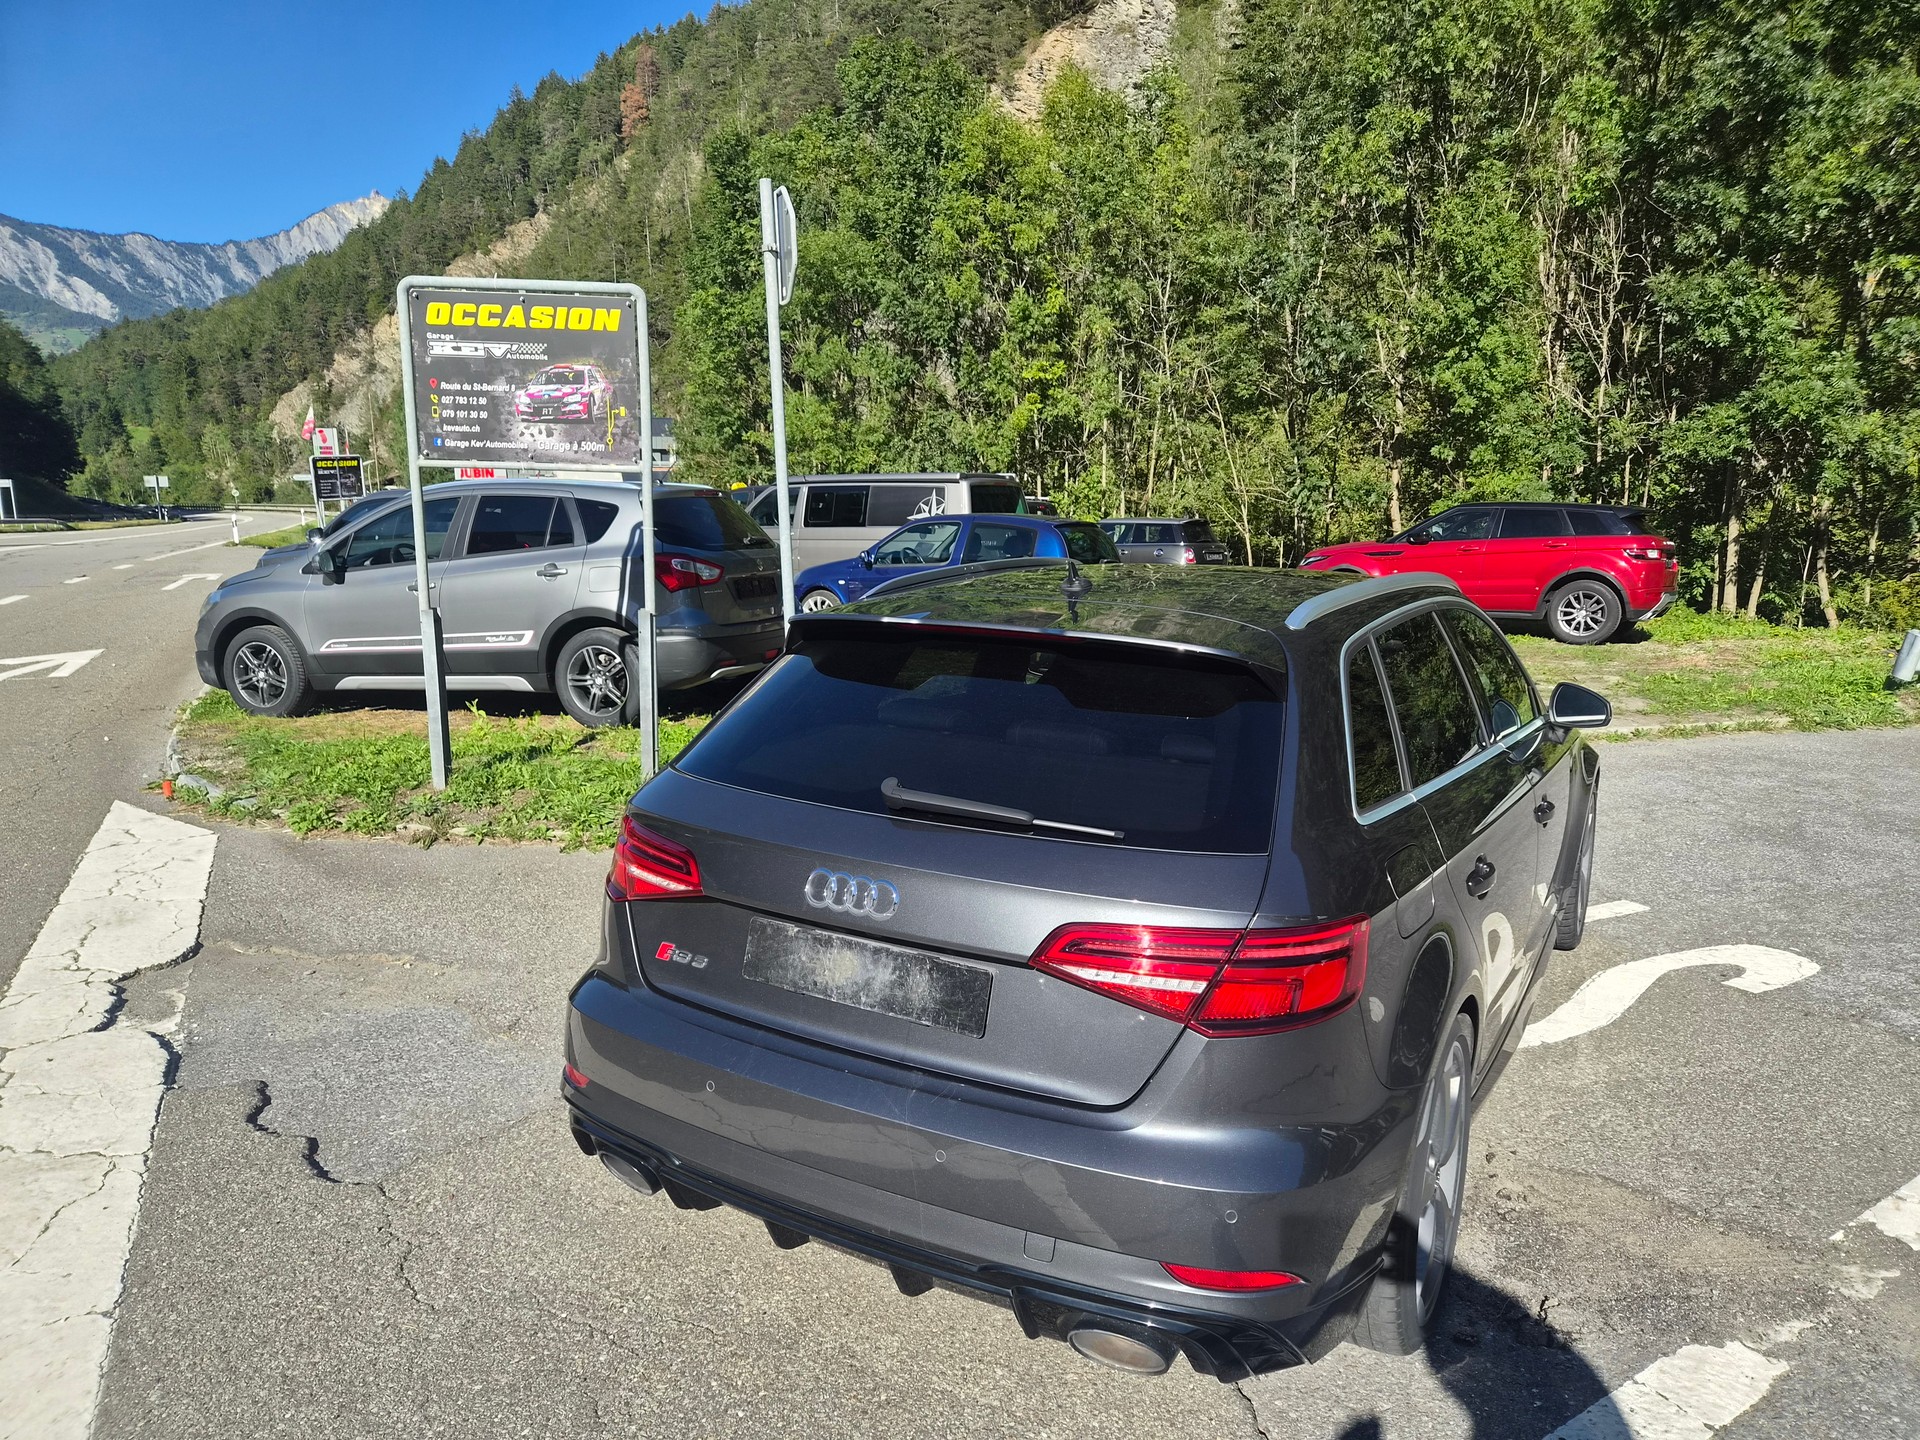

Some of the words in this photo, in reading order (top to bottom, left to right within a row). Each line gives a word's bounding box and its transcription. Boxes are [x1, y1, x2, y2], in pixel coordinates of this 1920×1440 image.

[425, 302, 622, 332] OCCASION
[426, 332, 454, 341] Garage
[440, 382, 461, 390] Route
[462, 382, 471, 390] du
[472, 383, 510, 392] St-Bernard
[441, 396, 454, 404] 027
[455, 396, 467, 404] 783
[478, 397, 487, 405] 50
[442, 410, 455, 418] 079
[456, 410, 468, 418] 101
[470, 410, 478, 418] 30
[479, 411, 488, 419] 50
[443, 424, 480, 432] kevauto.ch
[444, 438, 470, 449] Garage
[537, 441, 572, 452] Garage
[573, 442, 579, 451] à
[580, 441, 605, 452] 500m
